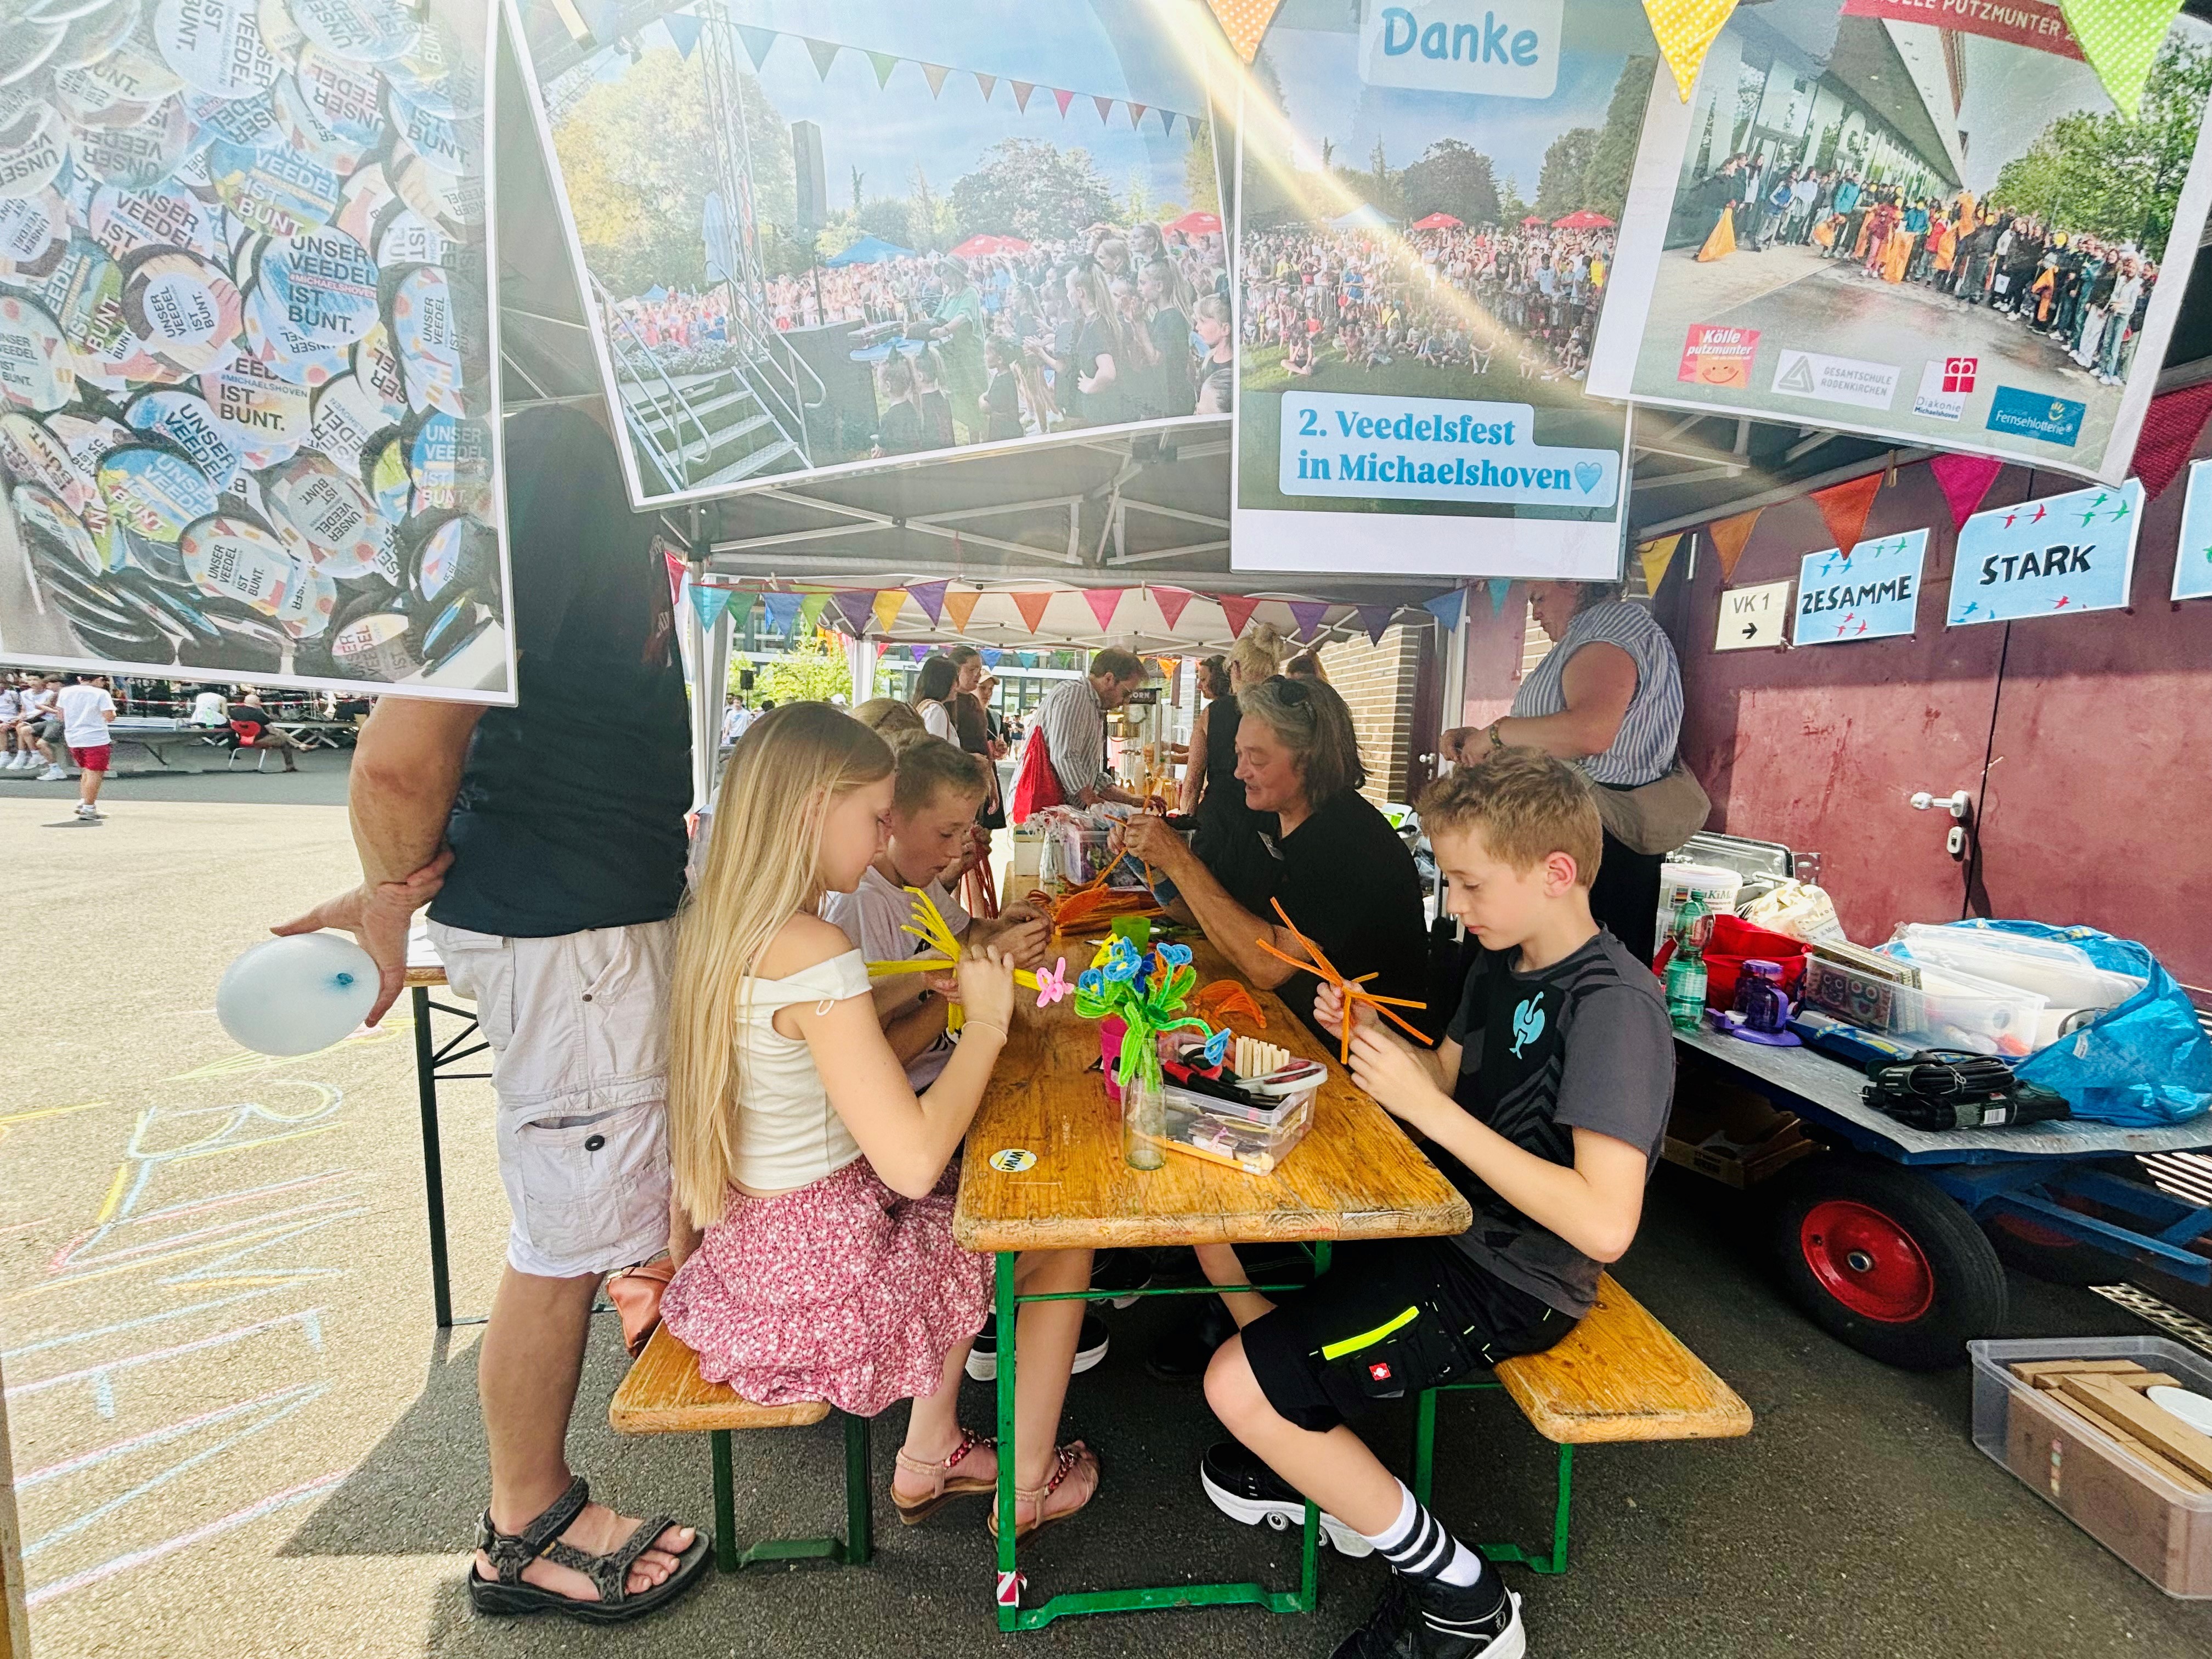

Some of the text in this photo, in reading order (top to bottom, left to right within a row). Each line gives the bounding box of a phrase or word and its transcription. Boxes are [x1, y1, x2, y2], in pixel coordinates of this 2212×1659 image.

[231, 12, 258, 88] VEEDEL
[1381, 7, 1538, 66] Danke
[253, 40, 274, 89] SER
[0, 148, 60, 187] UNSE
[129, 189, 199, 233] NSER
[102, 219, 139, 248] IST
[290, 236, 368, 264] UNSER
[410, 227, 425, 259] IST
[44, 251, 81, 314] EEDEL
[289, 252, 377, 287] VEEDEL
[289, 284, 324, 306] IST
[290, 274, 377, 299] #MICHAELSHOVEN
[150, 294, 176, 338] UNSER
[161, 286, 187, 336] VEEDEL
[189, 311, 205, 331] IST
[193, 291, 215, 329] BUNT.
[289, 304, 355, 335] BUNT.
[422, 297, 434, 342] UNSER
[433, 297, 444, 346] VEEDEL
[1685, 344, 1753, 357] putzmunter
[1702, 329, 1741, 344] Kölle
[370, 369, 409, 404] SER
[1820, 378, 1888, 396] RODENKIRCHEN
[1824, 366, 1892, 385] GESAMTSCHULE
[221, 383, 255, 405] IST
[1916, 396, 1961, 413] Diakonie
[220, 403, 285, 432] BUNT.
[426, 425, 481, 443] UNSER
[1298, 408, 1516, 446] 2. Veedelsfest
[165, 411, 225, 484] VEEDEL
[180, 403, 238, 470] UNSER
[1297, 449, 1571, 490] in Michaelshoven
[145, 465, 208, 519] VEEDE
[299, 477, 329, 506] BUNT.
[321, 487, 338, 506] IST
[315, 502, 353, 534] VEEDEL
[329, 511, 362, 542] UNSER
[207, 544, 225, 579] UNSER
[219, 548, 237, 584] VEEDEL
[1979, 545, 2097, 585] STARK
[236, 574, 248, 592] IST
[247, 567, 264, 596] BUNT.
[1802, 575, 1912, 615] ZESAMME
[1733, 592, 1770, 614] VK 1
